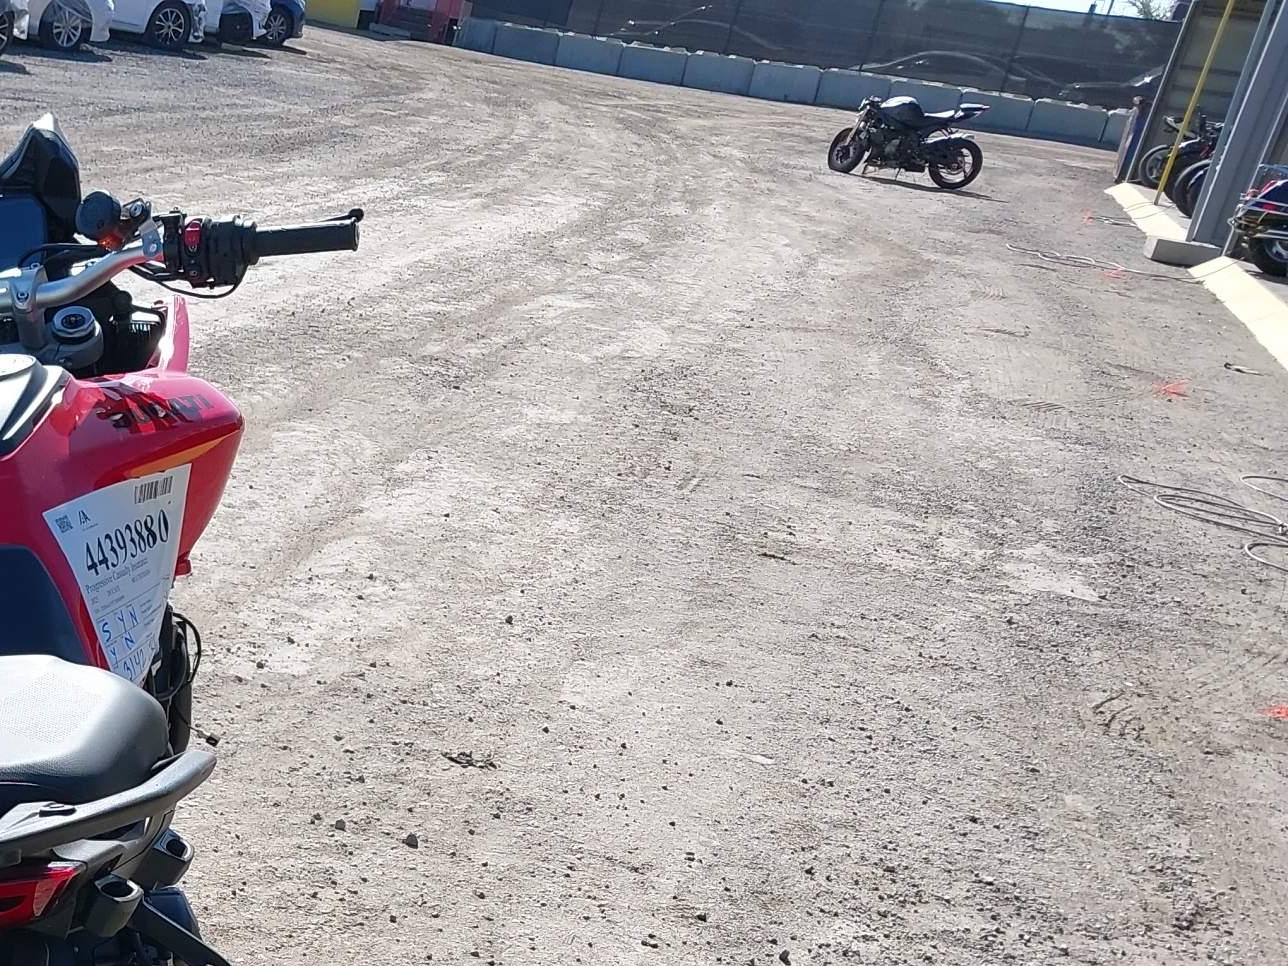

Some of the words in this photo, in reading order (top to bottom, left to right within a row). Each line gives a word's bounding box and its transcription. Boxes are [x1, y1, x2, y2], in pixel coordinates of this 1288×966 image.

[86, 509, 169, 576] 44393880
[102, 622, 111, 642] S
[128, 606, 139, 627] N
